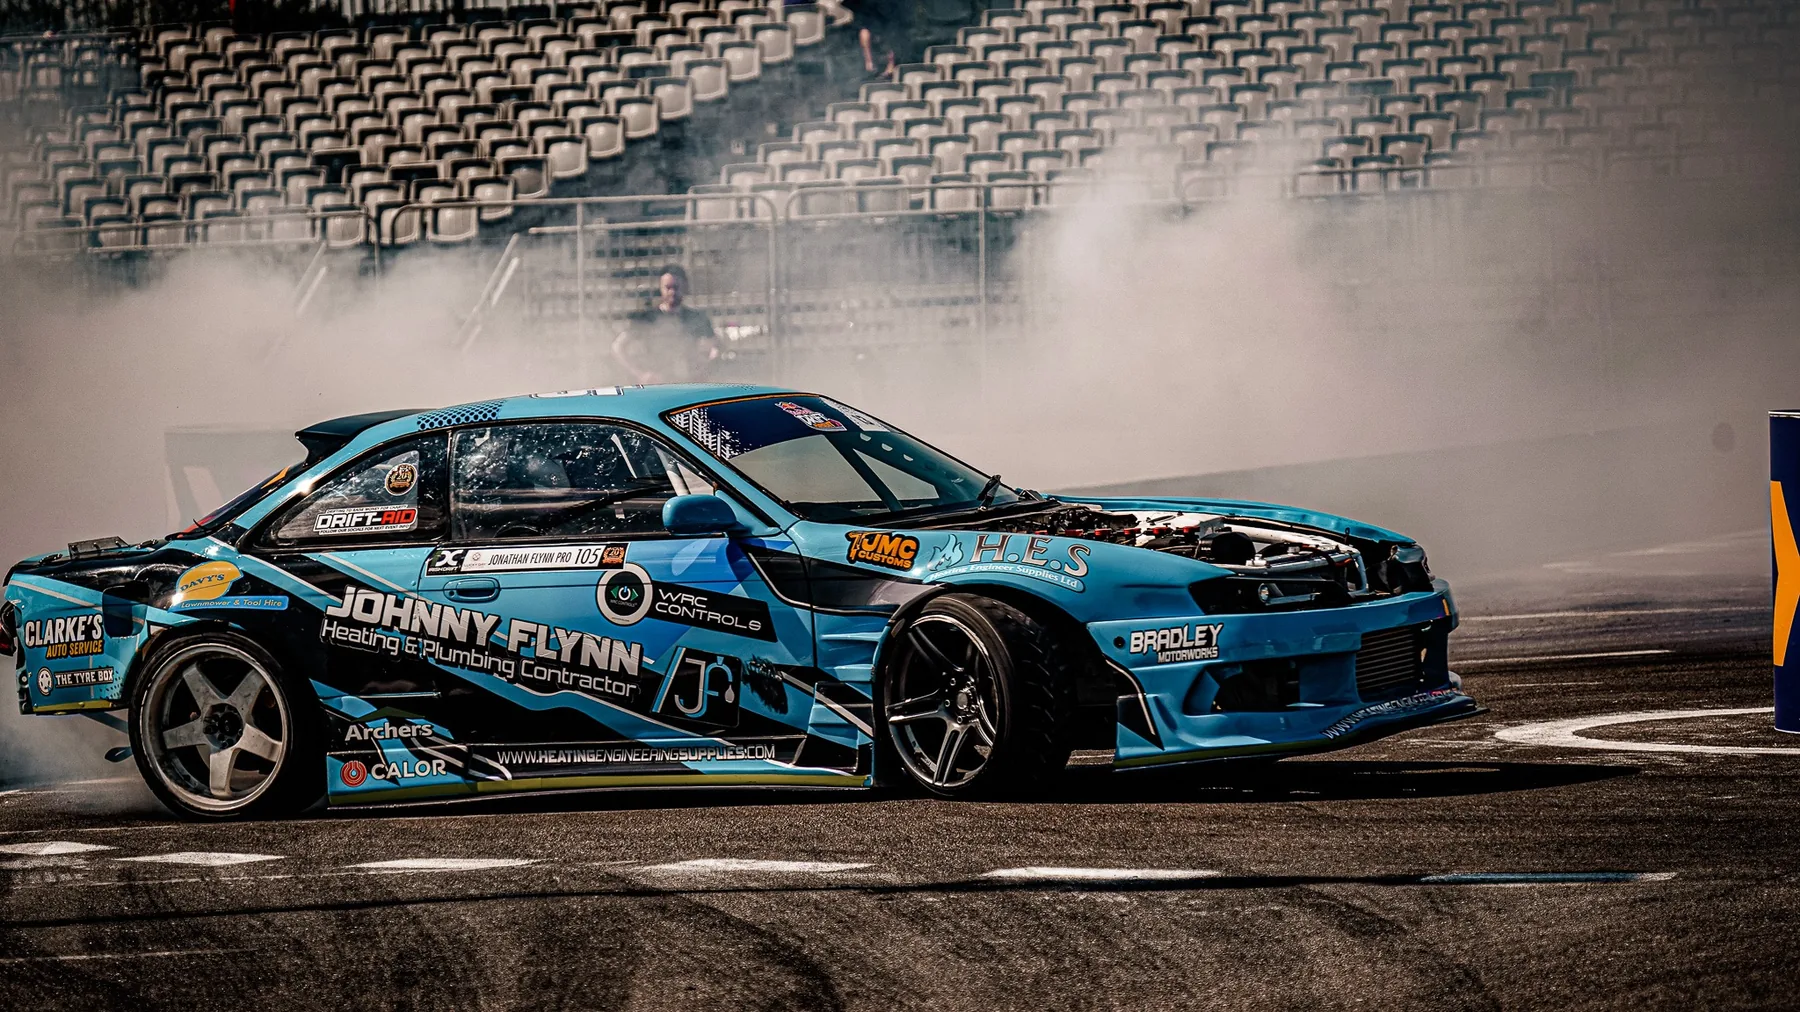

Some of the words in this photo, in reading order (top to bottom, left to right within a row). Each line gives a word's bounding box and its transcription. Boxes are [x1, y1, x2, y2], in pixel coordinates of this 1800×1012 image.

[316, 508, 416, 529] DRIFT-AID
[488, 553, 528, 566] JONATHAN
[530, 552, 555, 564] FLYNN
[555, 552, 572, 562] PRO
[574, 548, 601, 565] 105
[858, 550, 912, 568] CUSTOMS
[179, 573, 225, 592] DAVY'S
[969, 563, 1014, 571] Engineer
[1016, 565, 1059, 581] Supplies
[1060, 575, 1078, 589] Ltd
[263, 599, 282, 607] Hire
[658, 588, 708, 608] WRC
[655, 602, 762, 631] CONTROLS
[25, 614, 103, 647] CLARKE'S
[325, 586, 499, 647] JOHNNY
[507, 619, 642, 677] FLYNN
[1129, 624, 1223, 654] BRADLEY
[46, 643, 68, 658] AUTO
[69, 640, 103, 656] SERVICE
[322, 619, 400, 656] Heating
[404, 636, 418, 655] &
[422, 638, 515, 679] Plumbing
[521, 660, 638, 697] Contractor
[1157, 646, 1218, 663] MOTORWORKS
[55, 672, 73, 685] THE
[73, 671, 96, 684] TYRE
[97, 669, 114, 682] BOX
[344, 723, 433, 741] Archers
[371, 760, 447, 780] CALOR
